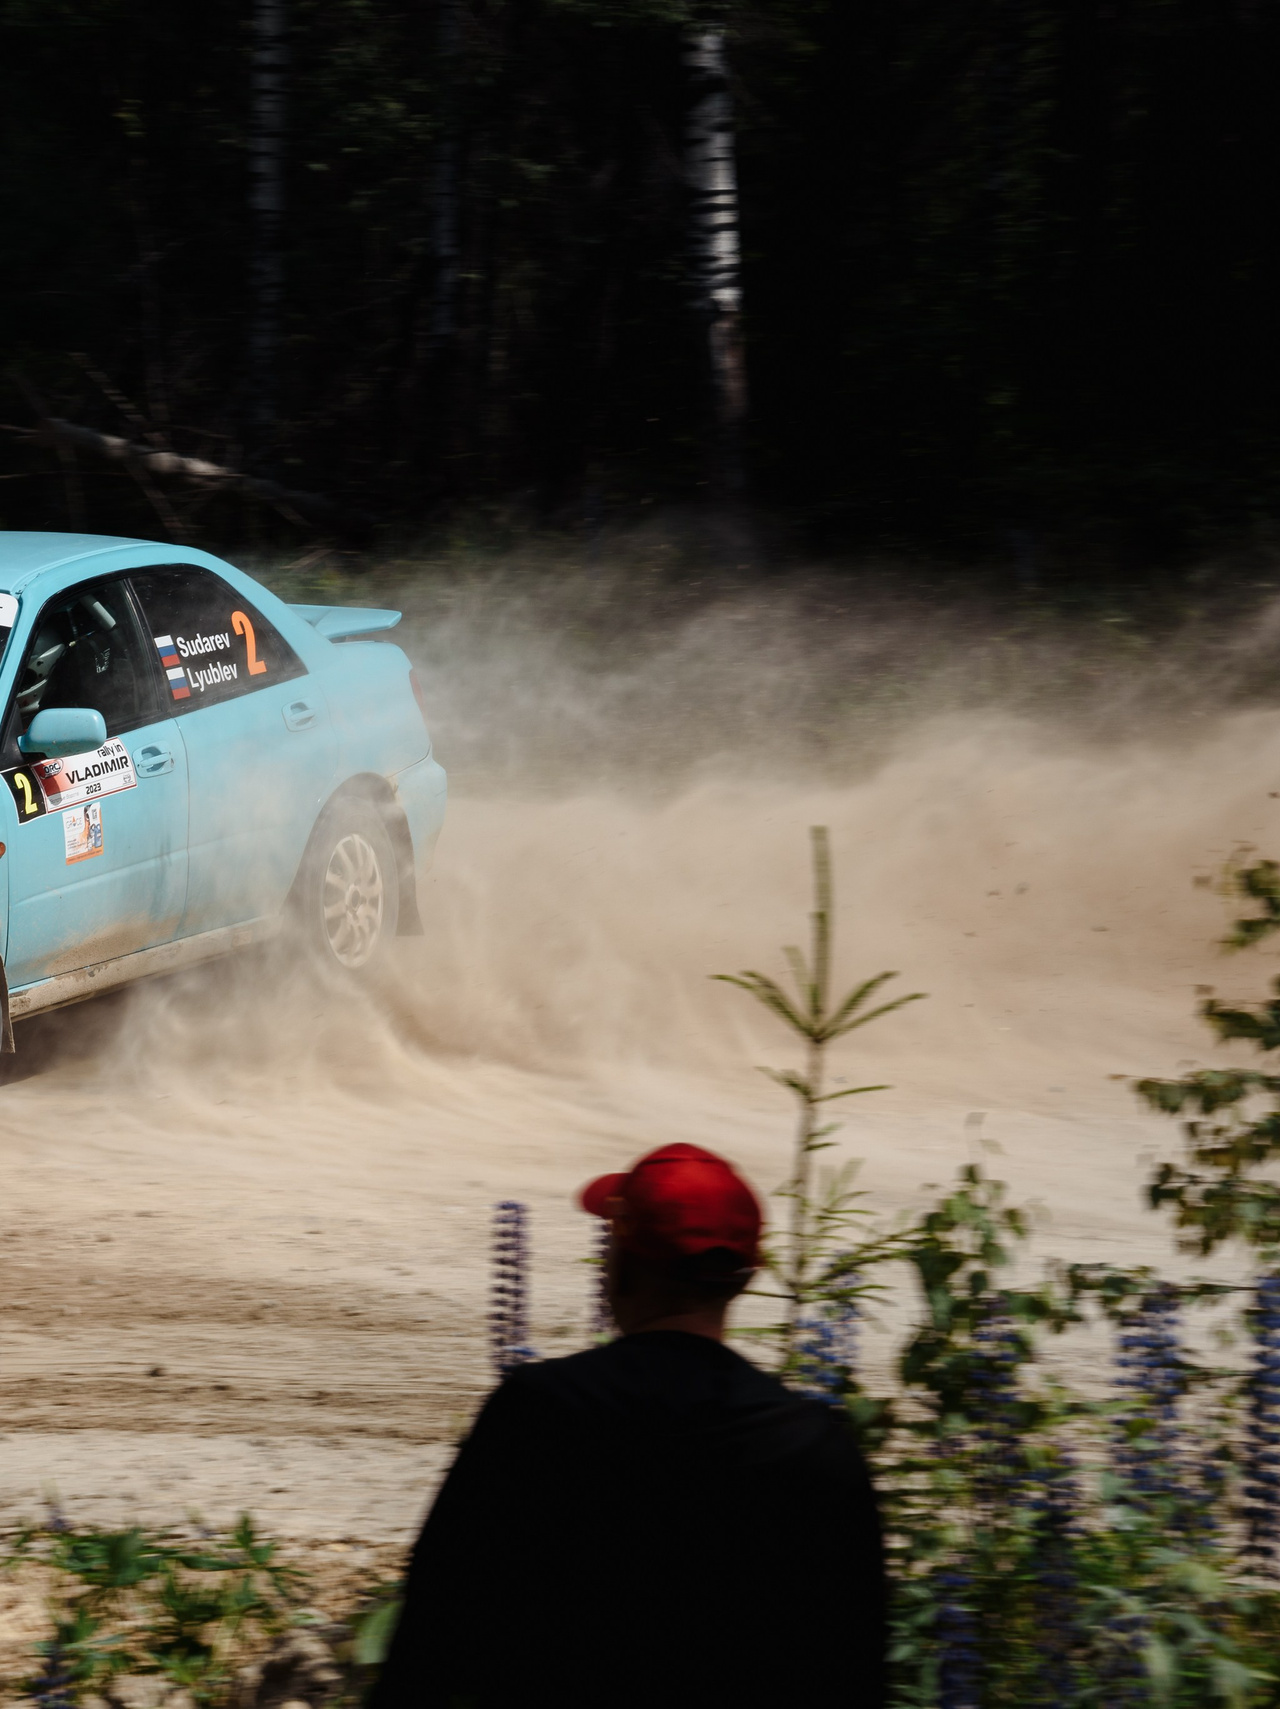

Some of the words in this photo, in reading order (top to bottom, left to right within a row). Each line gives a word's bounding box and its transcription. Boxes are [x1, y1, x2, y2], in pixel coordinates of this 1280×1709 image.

[176, 632, 231, 658] Sudarev
[231, 610, 267, 676] 2
[186, 662, 238, 692] Lyublev
[97, 746, 115, 757] rally
[113, 743, 124, 752] in
[65, 755, 130, 784] VLADIMIR
[13, 772, 39, 815] 2
[85, 782, 102, 795] 2023
